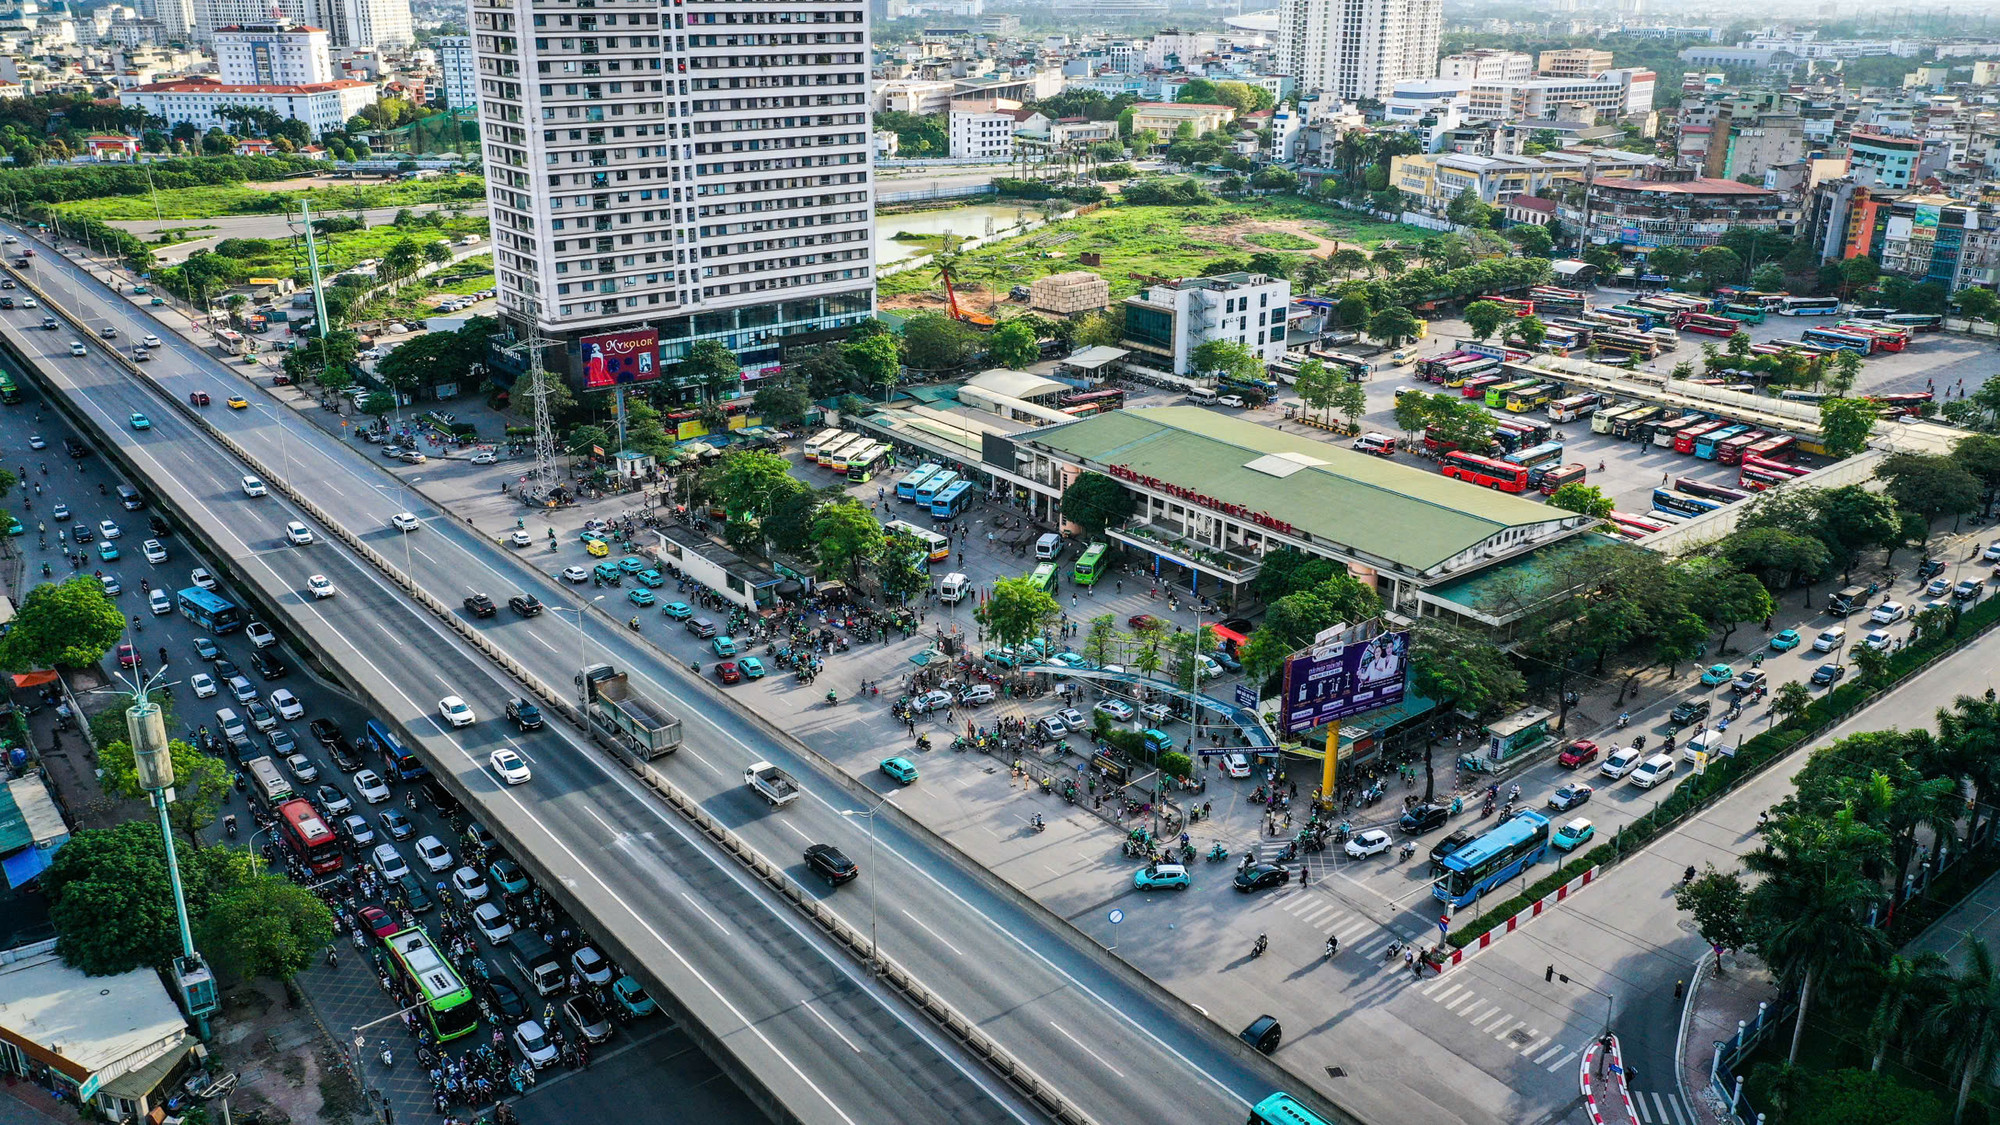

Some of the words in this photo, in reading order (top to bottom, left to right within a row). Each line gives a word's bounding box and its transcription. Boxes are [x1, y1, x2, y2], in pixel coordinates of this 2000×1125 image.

[606, 338, 653, 354] MYKOLOR
[1109, 464, 1137, 482] BẾN
[1142, 474, 1161, 491] XE
[1165, 482, 1220, 510] KHÁCH
[1224, 503, 1248, 519] MỸ
[1253, 510, 1292, 535] ĐÌNH
